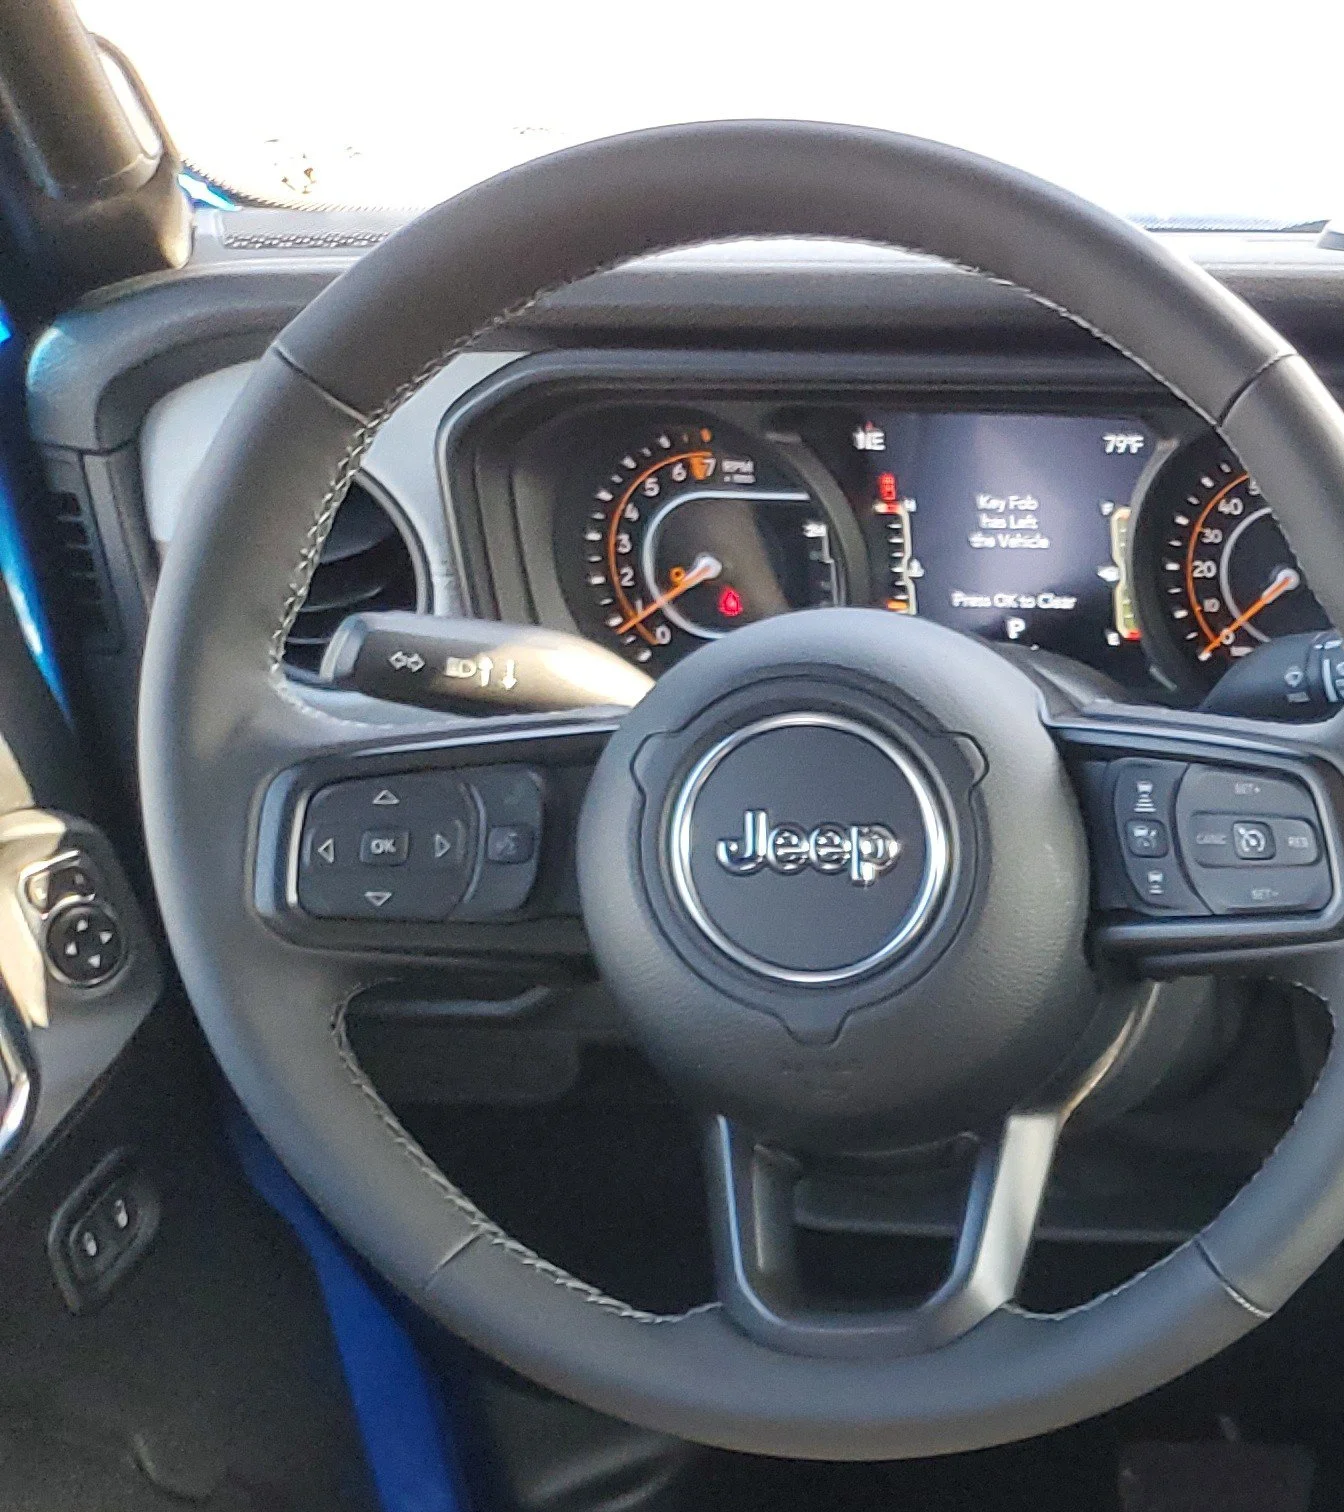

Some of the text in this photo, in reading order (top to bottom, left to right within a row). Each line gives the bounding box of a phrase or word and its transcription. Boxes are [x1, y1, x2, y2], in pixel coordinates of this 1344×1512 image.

[671, 463, 686, 482] 6
[703, 457, 716, 476] 7
[643, 477, 660, 497] 5
[623, 503, 640, 523] 4
[976, 495, 1039, 513] Key Fob
[1218, 498, 1244, 516] 40
[1008, 515, 1038, 530] Left
[616, 532, 632, 554] 3
[968, 532, 1050, 549] the Vehicle
[1200, 528, 1223, 545] 30
[620, 567, 635, 587] 2
[1192, 560, 1217, 579] 20
[951, 591, 992, 609] Press
[993, 593, 1017, 609] OK
[1037, 593, 1078, 609] Clear
[655, 624, 672, 645] 0
[1006, 617, 1026, 639] P
[372, 838, 397, 855] OK
[717, 810, 901, 887] Jeep
